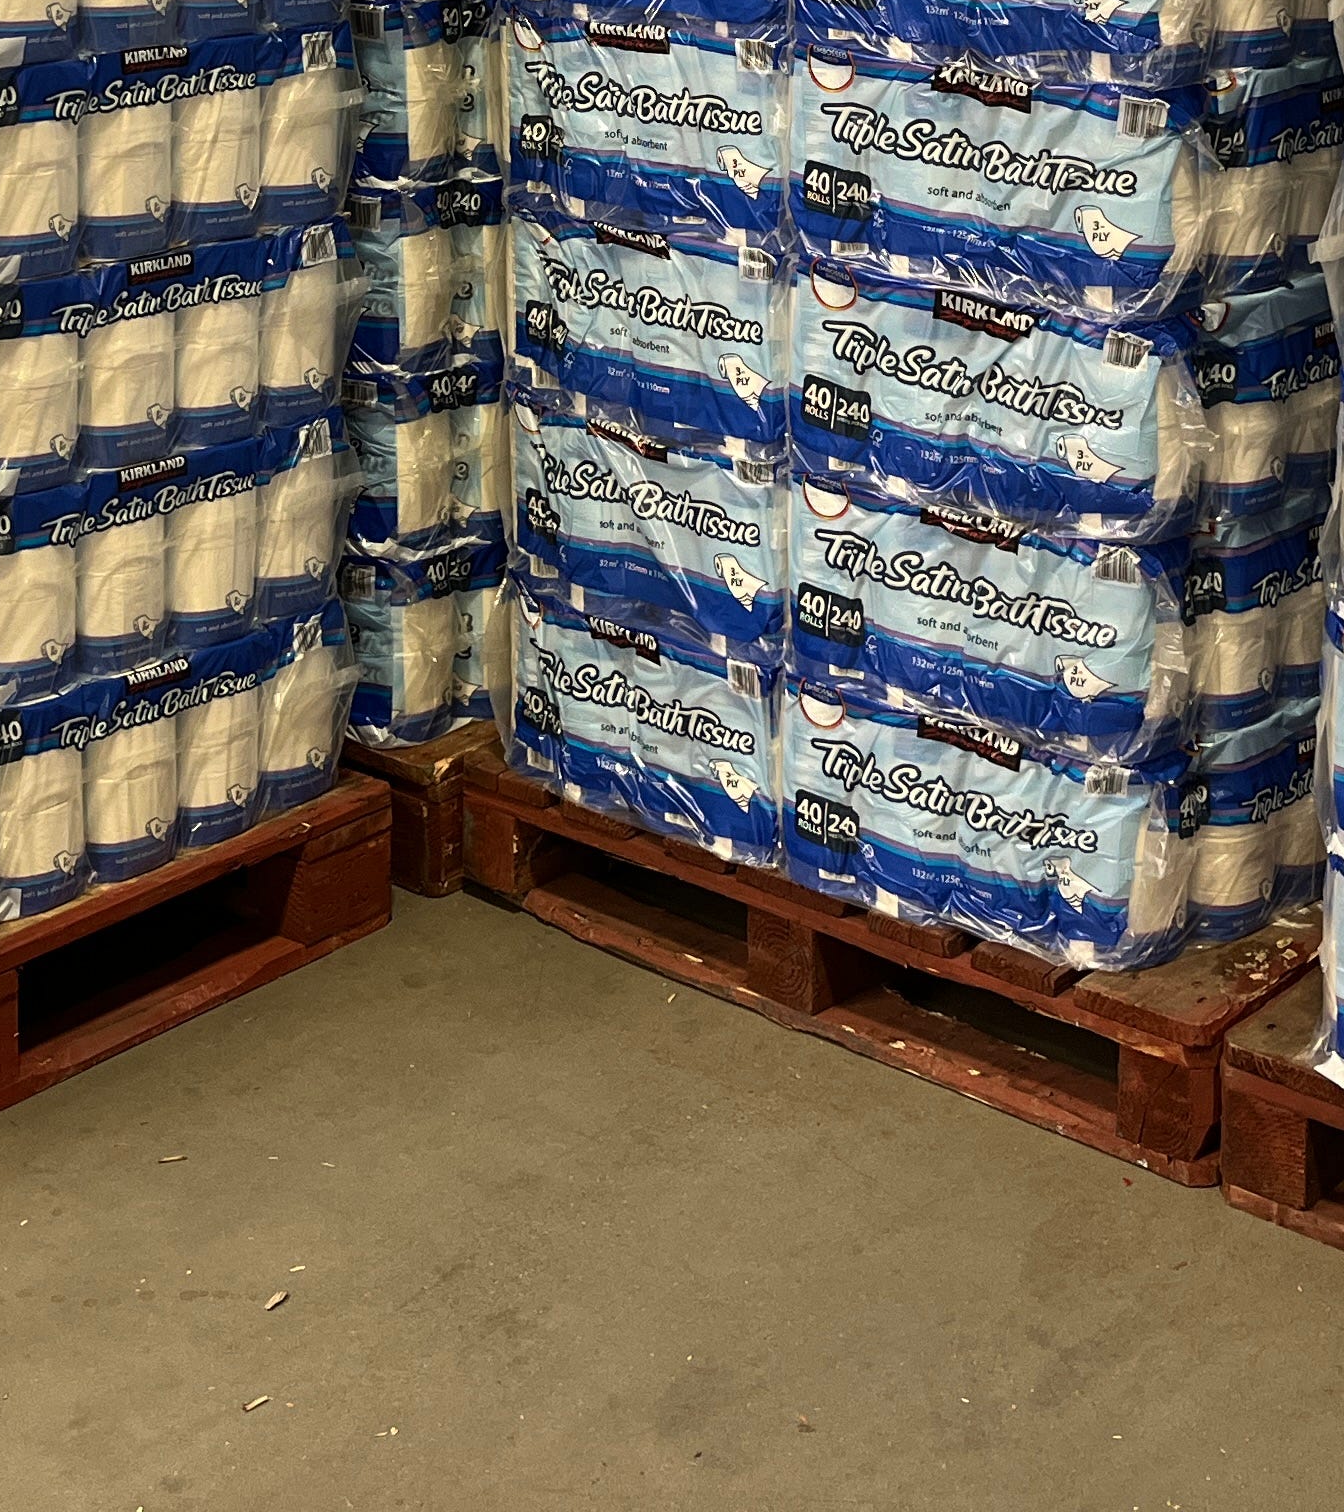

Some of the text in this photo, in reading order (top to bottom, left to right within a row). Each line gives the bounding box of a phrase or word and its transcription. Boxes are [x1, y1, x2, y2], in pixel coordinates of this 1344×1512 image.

[131, 254, 191, 275] KIRKLAND
[823, 320, 974, 398] Triple Satin
[804, 383, 870, 421] 40 240
